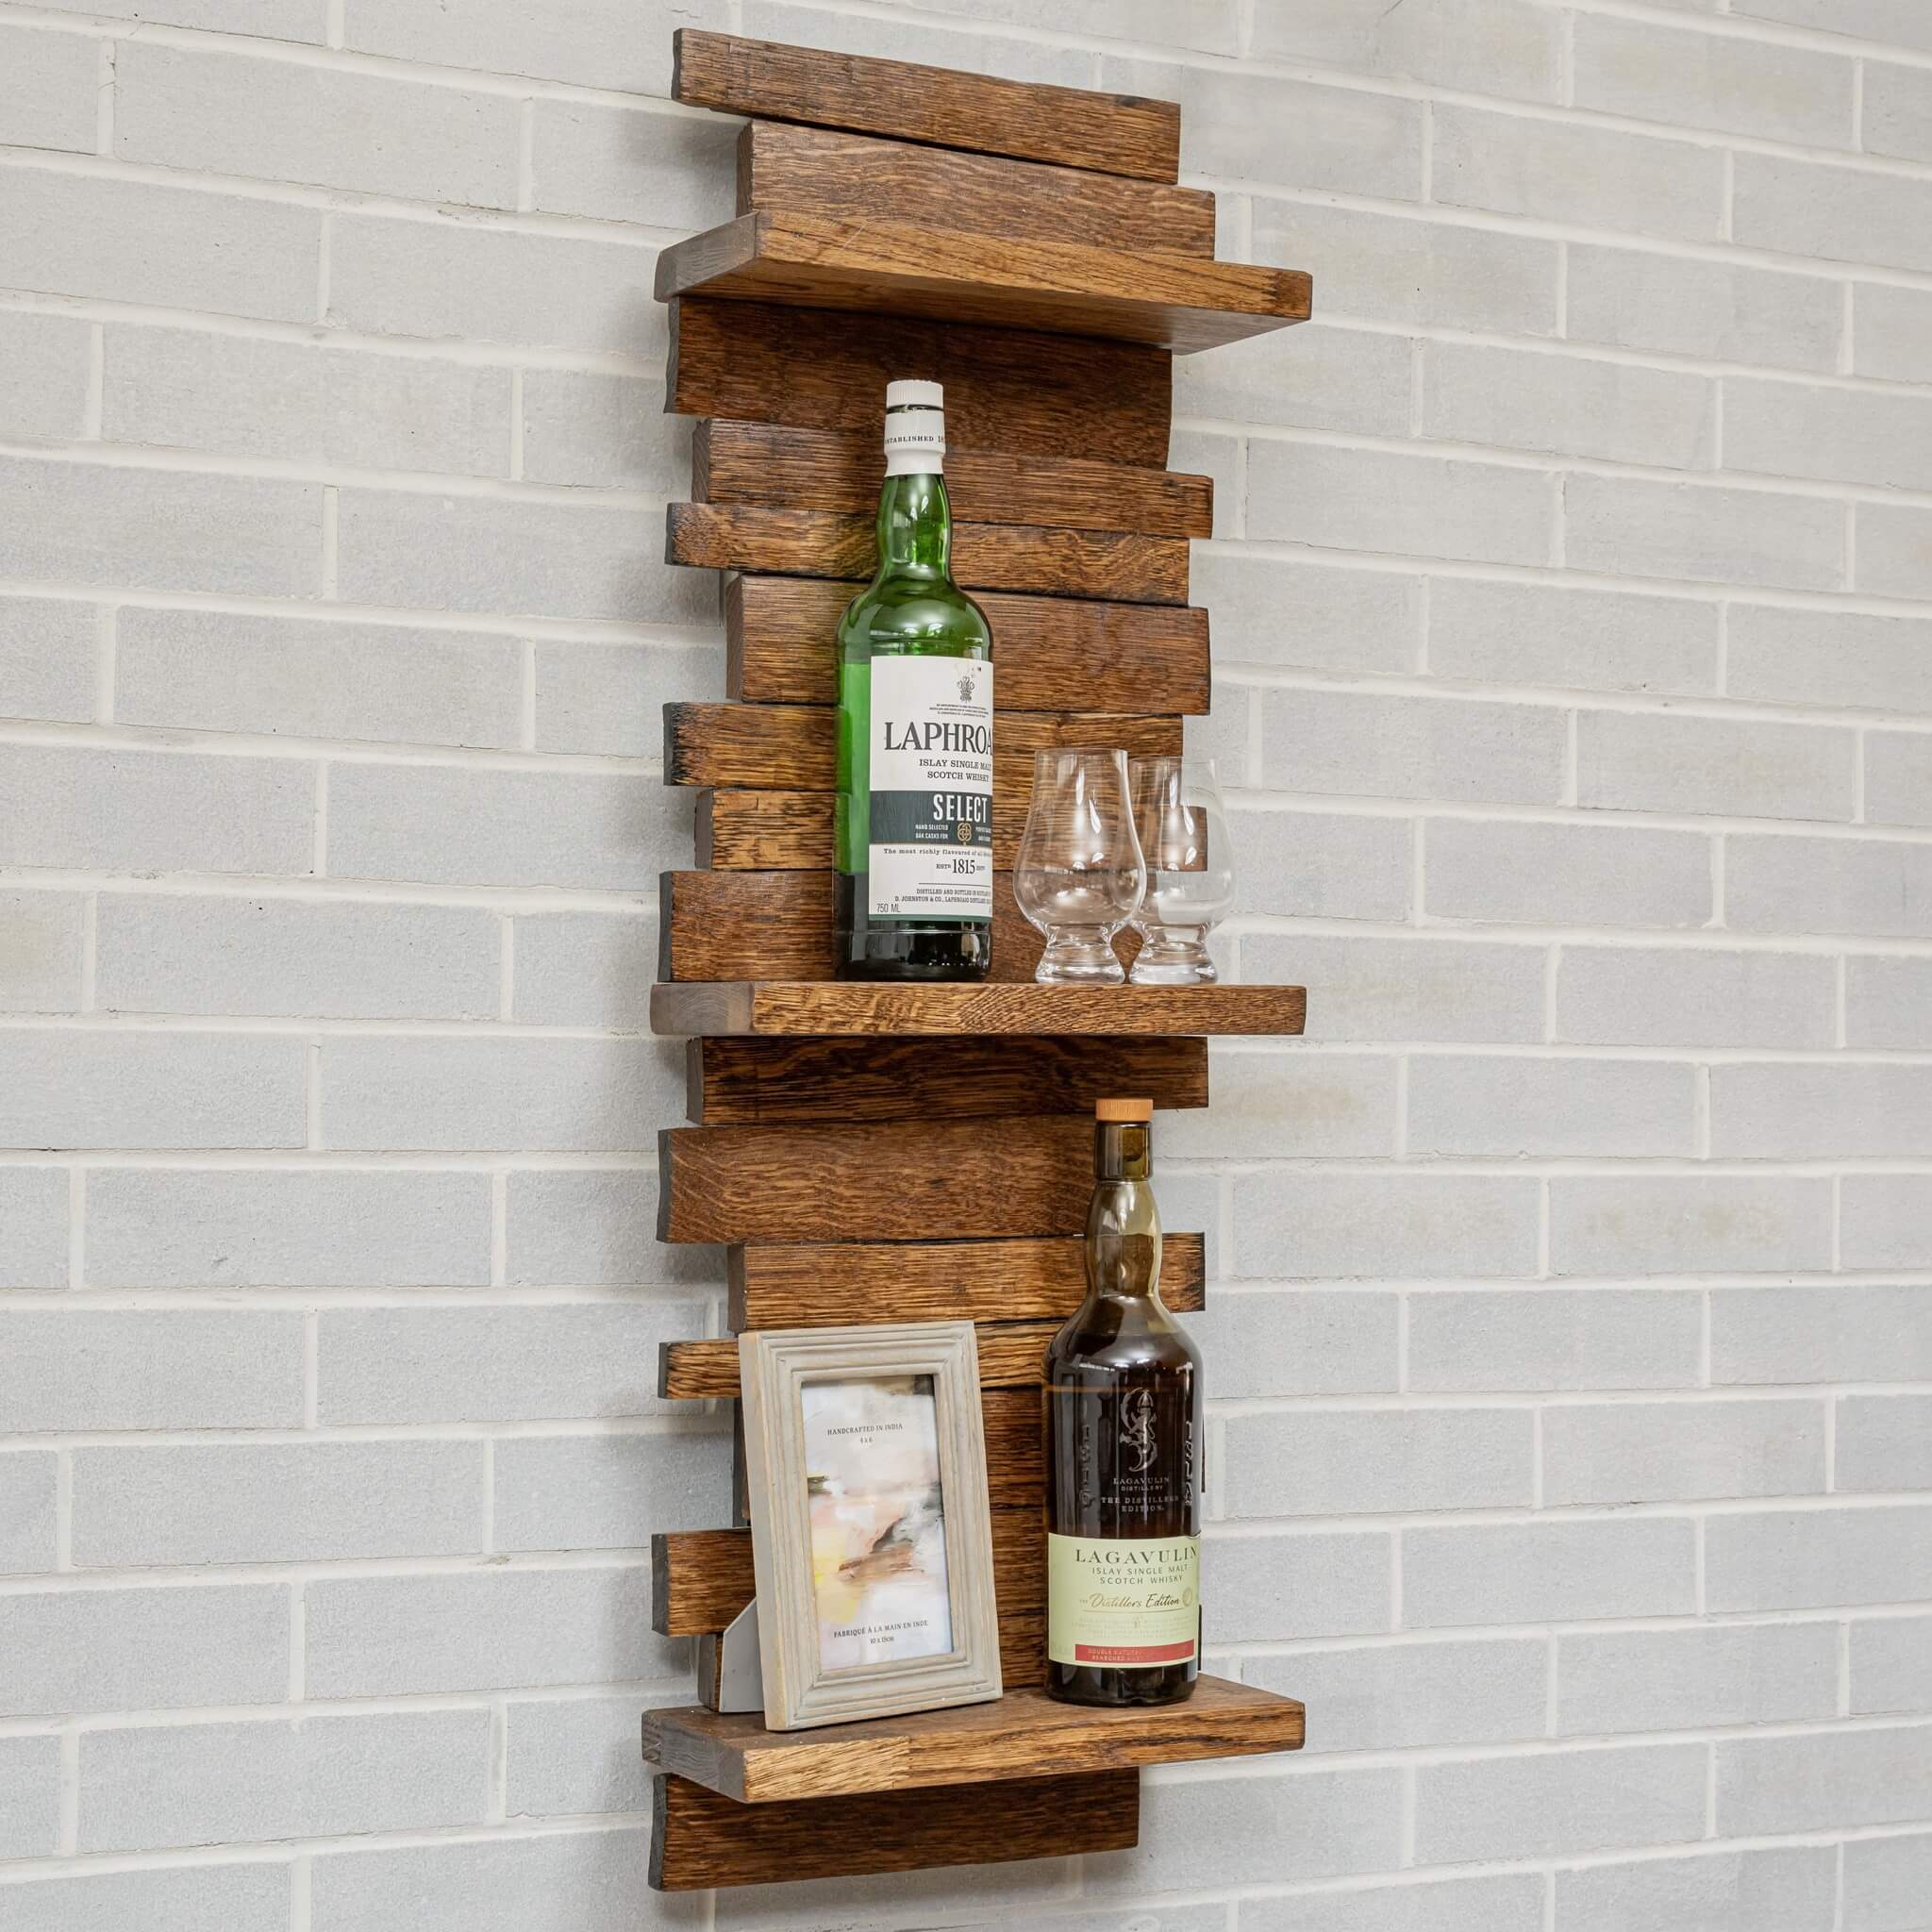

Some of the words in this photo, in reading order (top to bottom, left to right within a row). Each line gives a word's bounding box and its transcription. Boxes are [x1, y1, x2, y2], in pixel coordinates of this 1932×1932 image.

[919, 758, 948, 768] ISLAY
[950, 759, 979, 770] SINGLE
[927, 771, 963, 780] SCOTCH
[965, 773, 990, 783] WHISKY
[933, 793, 988, 824] SELECT
[952, 858, 975, 874] 1815
[876, 903, 890, 913] 750
[891, 903, 901, 913] ML
[827, 1425, 874, 1435] HANDCRAFTED
[884, 1423, 903, 1431] INDIA
[1113, 1476, 1171, 1486] LAGAVULIN
[1101, 1496, 1121, 1505] THE
[1075, 1545, 1197, 1564] LAGAVULIN
[1092, 1567, 1122, 1575] ISLAY
[1126, 1566, 1163, 1575] SINGLE
[1169, 1563, 1189, 1573] MALT
[1100, 1576, 1143, 1585] SCOTCH
[1151, 1574, 1184, 1585] WHISKY
[1089, 1592, 1142, 1608] Distillers
[1145, 1592, 1180, 1608] Edition
[874, 1624, 883, 1634] LA
[884, 1623, 902, 1632] MAIN
[903, 1622, 912, 1630] EN
[913, 1620, 929, 1628] INDE
